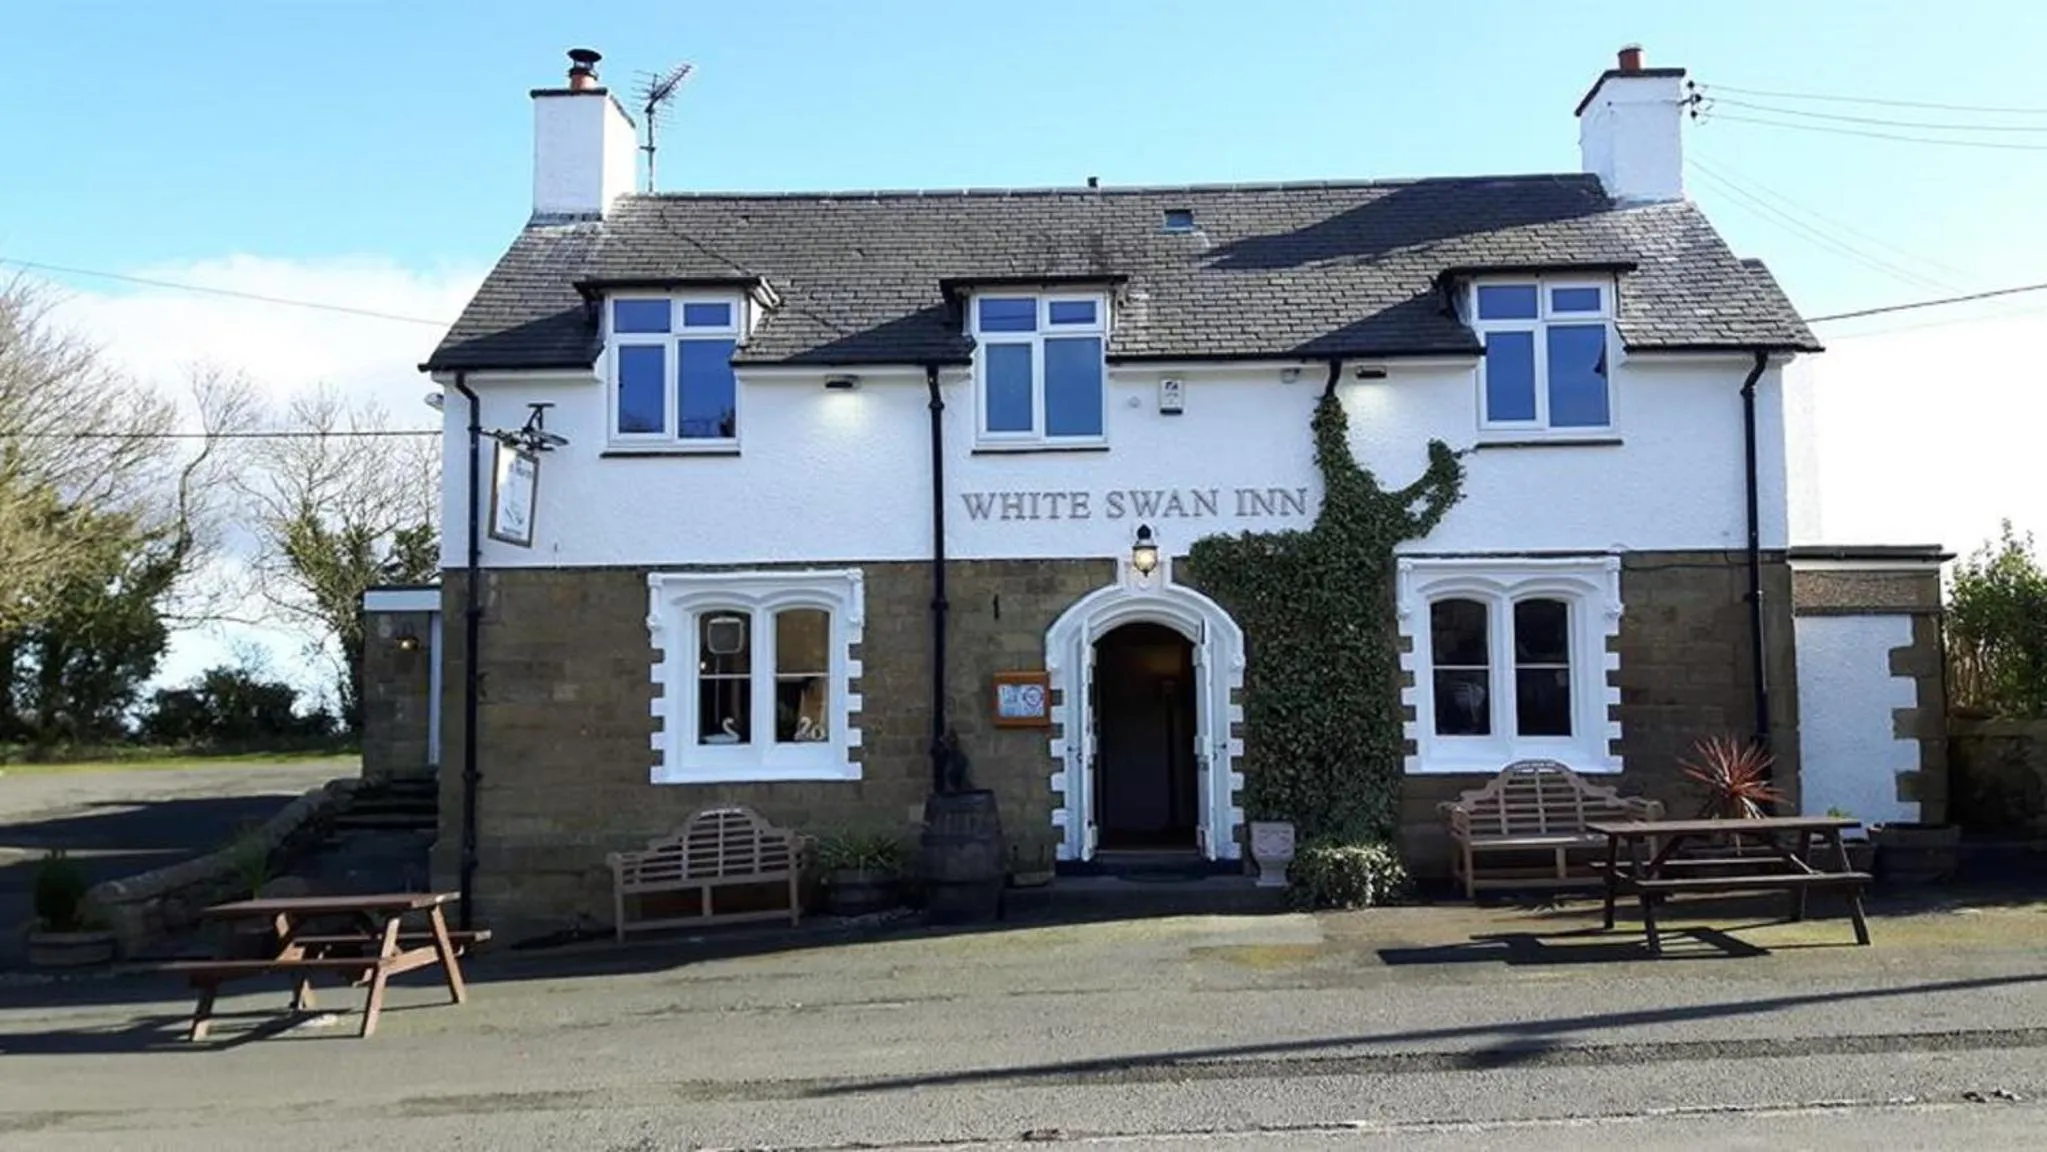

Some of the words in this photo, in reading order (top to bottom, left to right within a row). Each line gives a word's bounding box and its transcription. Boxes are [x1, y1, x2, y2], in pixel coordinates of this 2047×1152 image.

[962, 491, 1091, 520] WHITE
[1105, 488, 1219, 519] SWAN
[1234, 487, 1307, 518] INN
